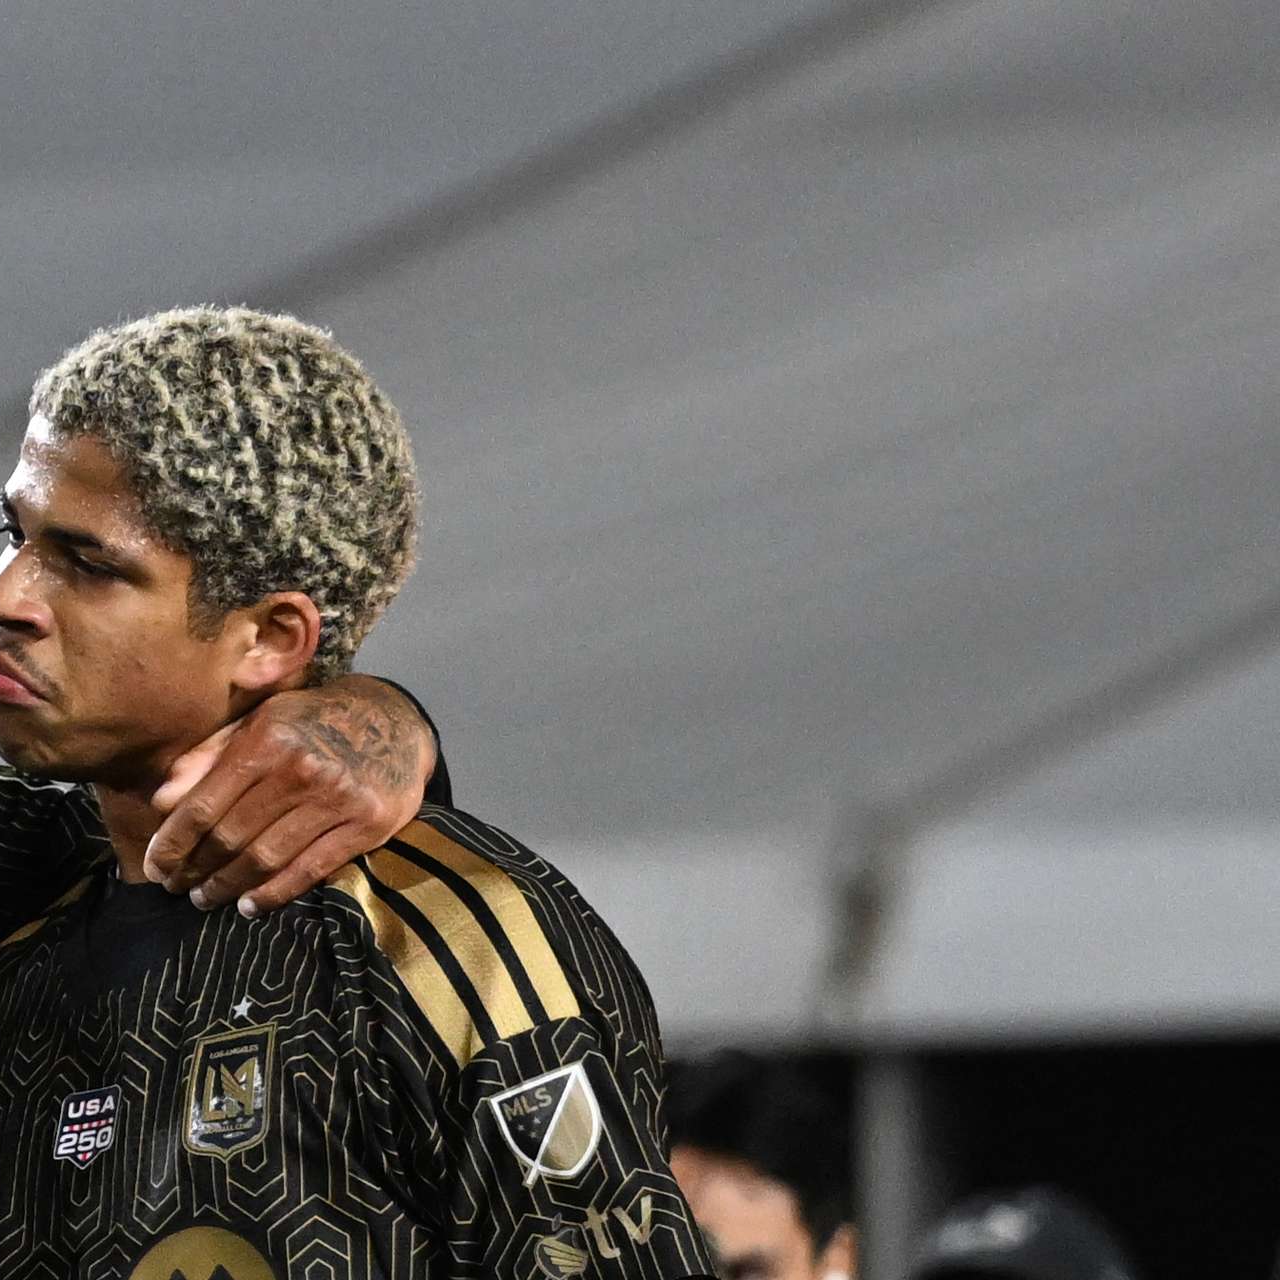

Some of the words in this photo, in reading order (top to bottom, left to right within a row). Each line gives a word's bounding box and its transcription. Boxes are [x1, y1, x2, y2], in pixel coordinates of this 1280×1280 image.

[68, 1095, 115, 1118] USA
[502, 1087, 553, 1122] MLS
[57, 1126, 113, 1155] 250
[585, 1193, 652, 1260] tv
